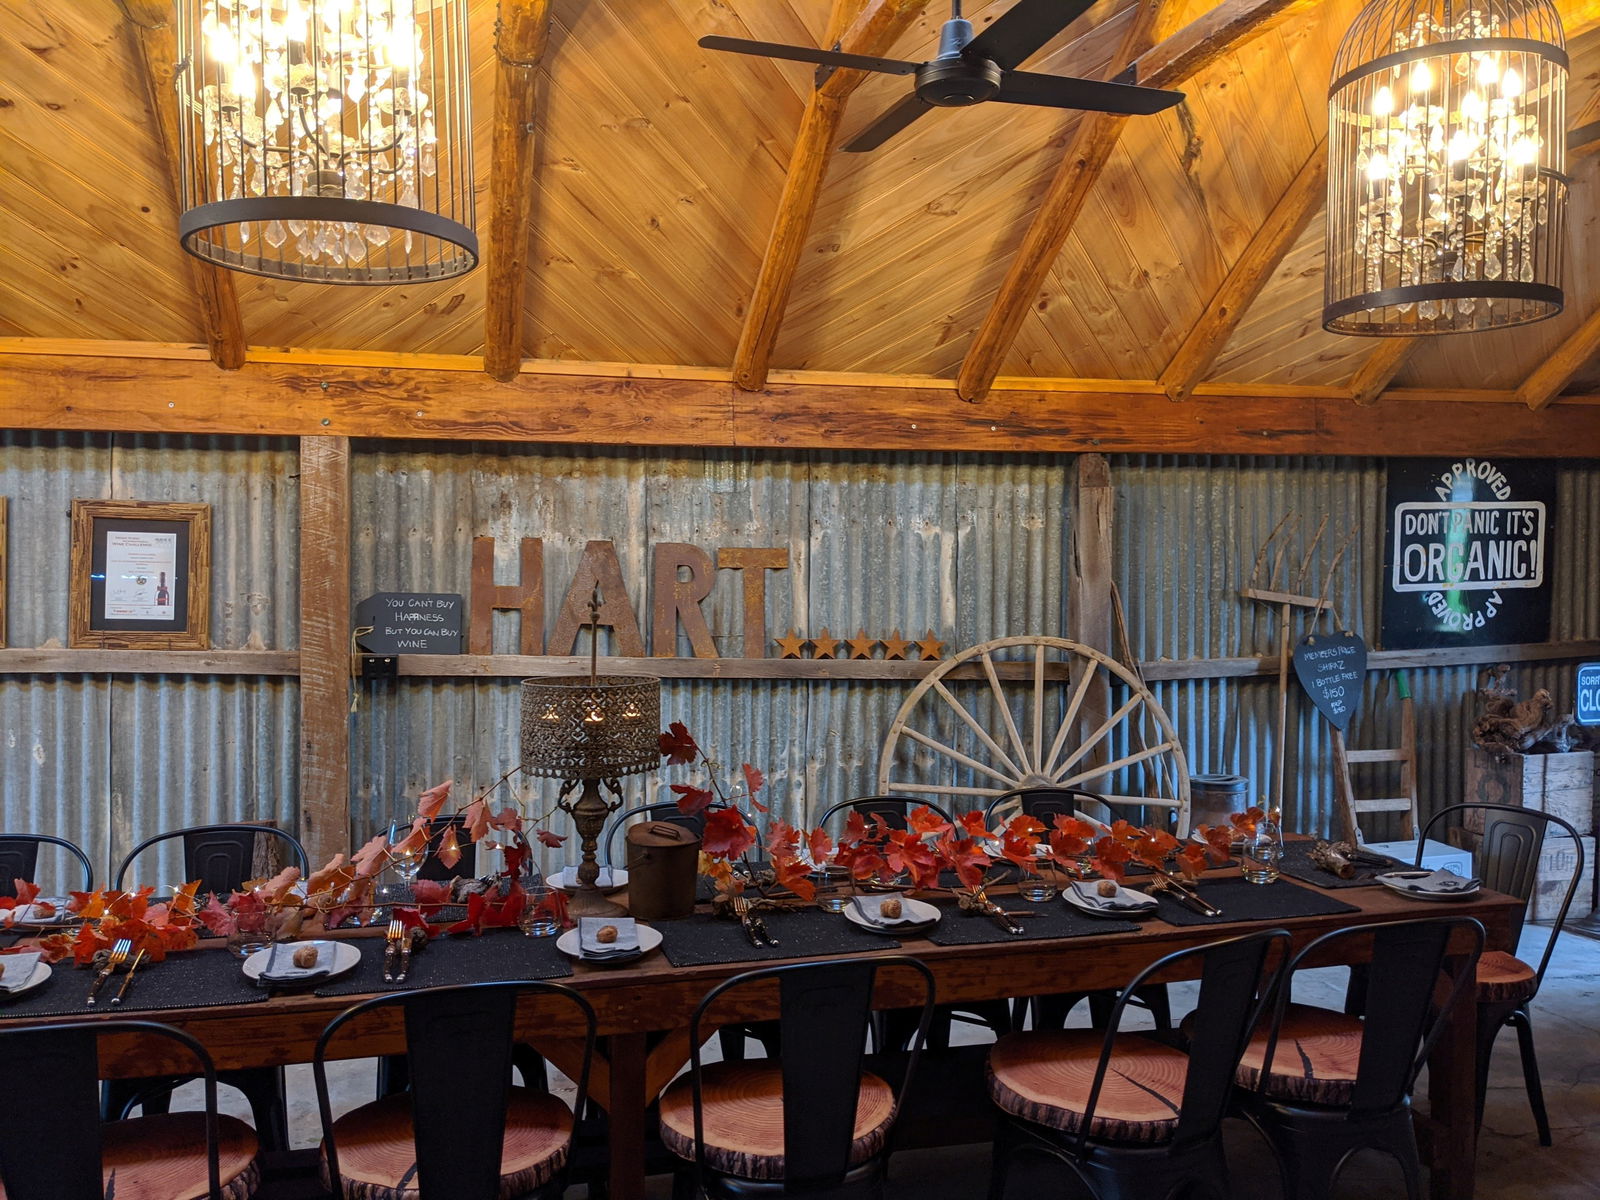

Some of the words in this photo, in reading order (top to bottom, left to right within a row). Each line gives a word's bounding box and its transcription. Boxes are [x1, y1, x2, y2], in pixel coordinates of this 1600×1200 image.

[1434, 458, 1512, 502] APPROVED
[1404, 511, 1449, 536] DON'T
[1452, 510, 1500, 535] PANIC
[1506, 509, 1535, 536] IT'S
[1403, 539, 1538, 582] ORGANIC!
[385, 598, 404, 608] YOU
[436, 600, 455, 609] BUY
[469, 536, 789, 659] HART
[1426, 590, 1504, 631] APPROVED
[385, 626, 403, 635] BUT
[405, 627, 422, 636] YOU
[423, 627, 439, 637] CAN
[440, 628, 458, 637] BUY
[397, 639, 428, 649] WINE
[1581, 675, 1600, 686] SORR
